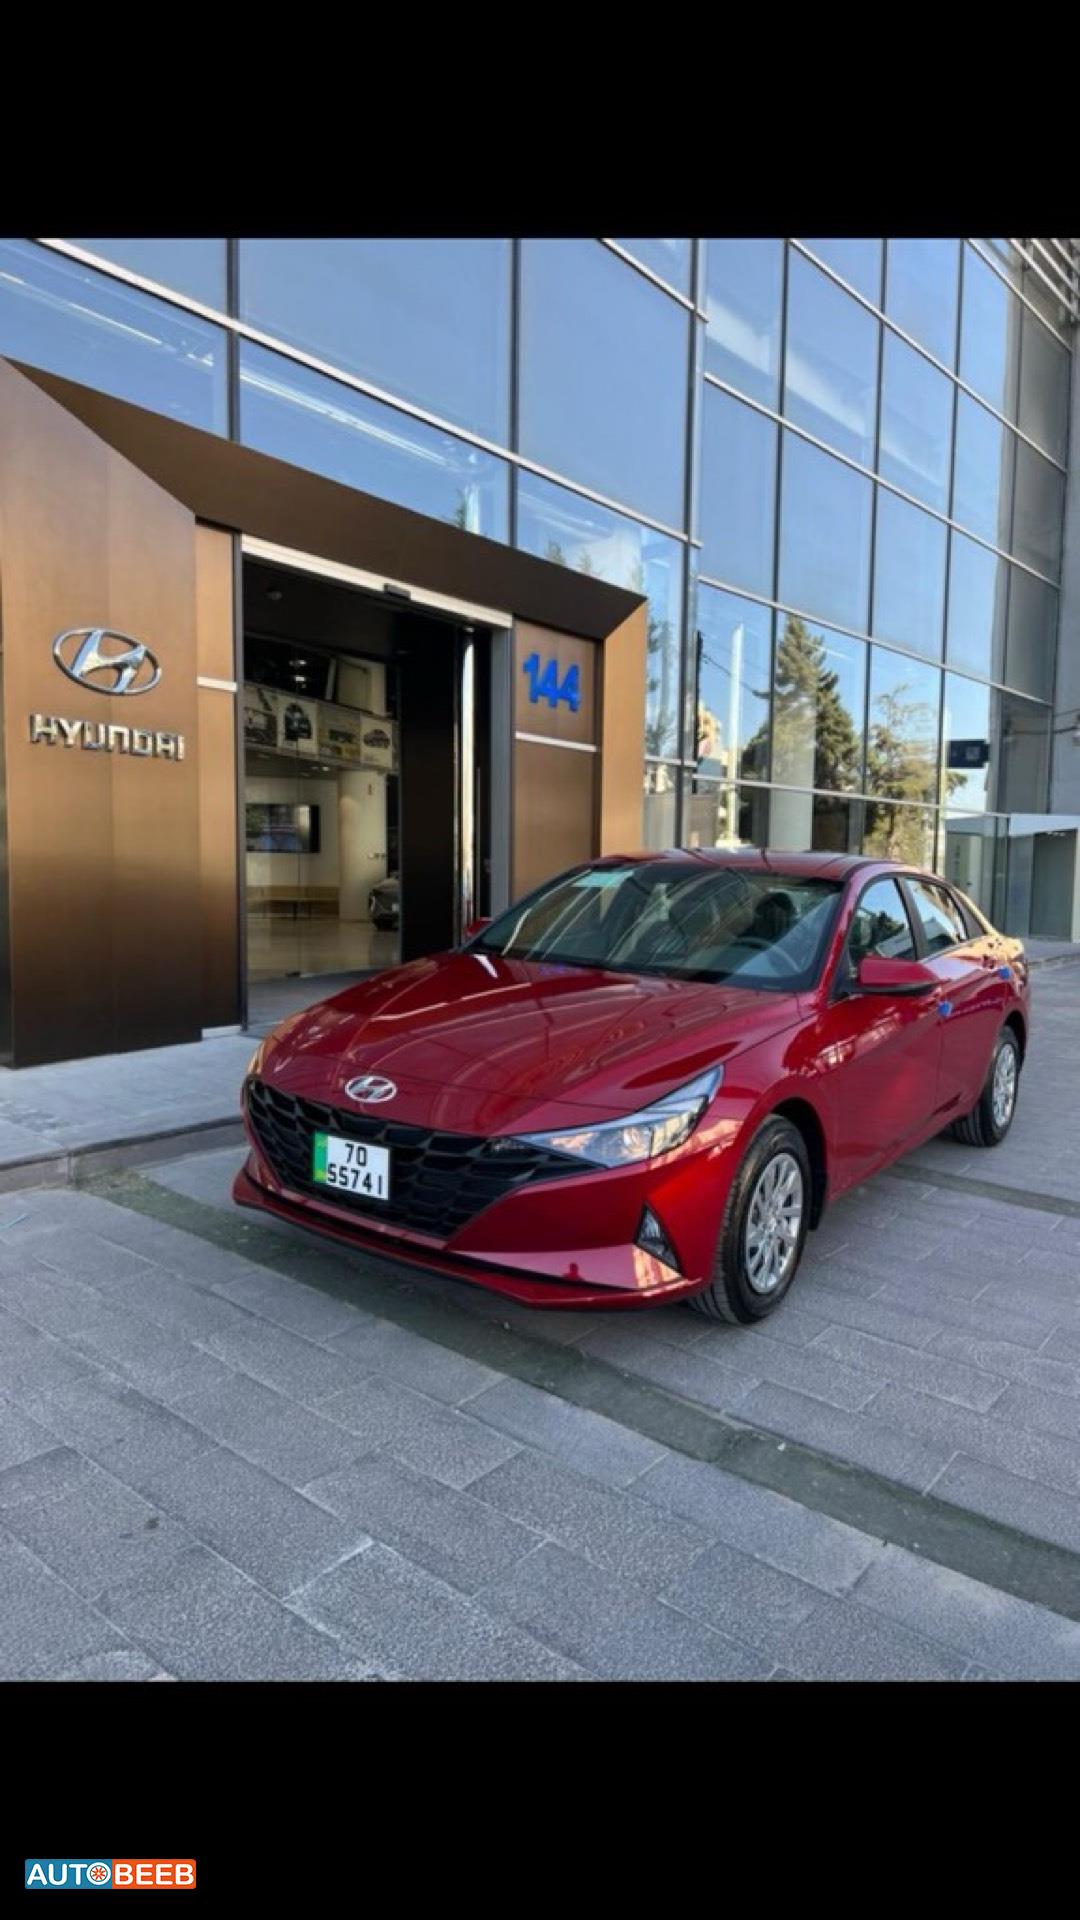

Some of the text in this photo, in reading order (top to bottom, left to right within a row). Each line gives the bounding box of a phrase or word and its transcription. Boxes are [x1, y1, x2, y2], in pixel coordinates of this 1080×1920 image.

[523, 653, 579, 713] 144
[30, 713, 185, 760] HYUNDAI
[345, 1143, 367, 1167] 70
[328, 1163, 382, 1195] 55741
